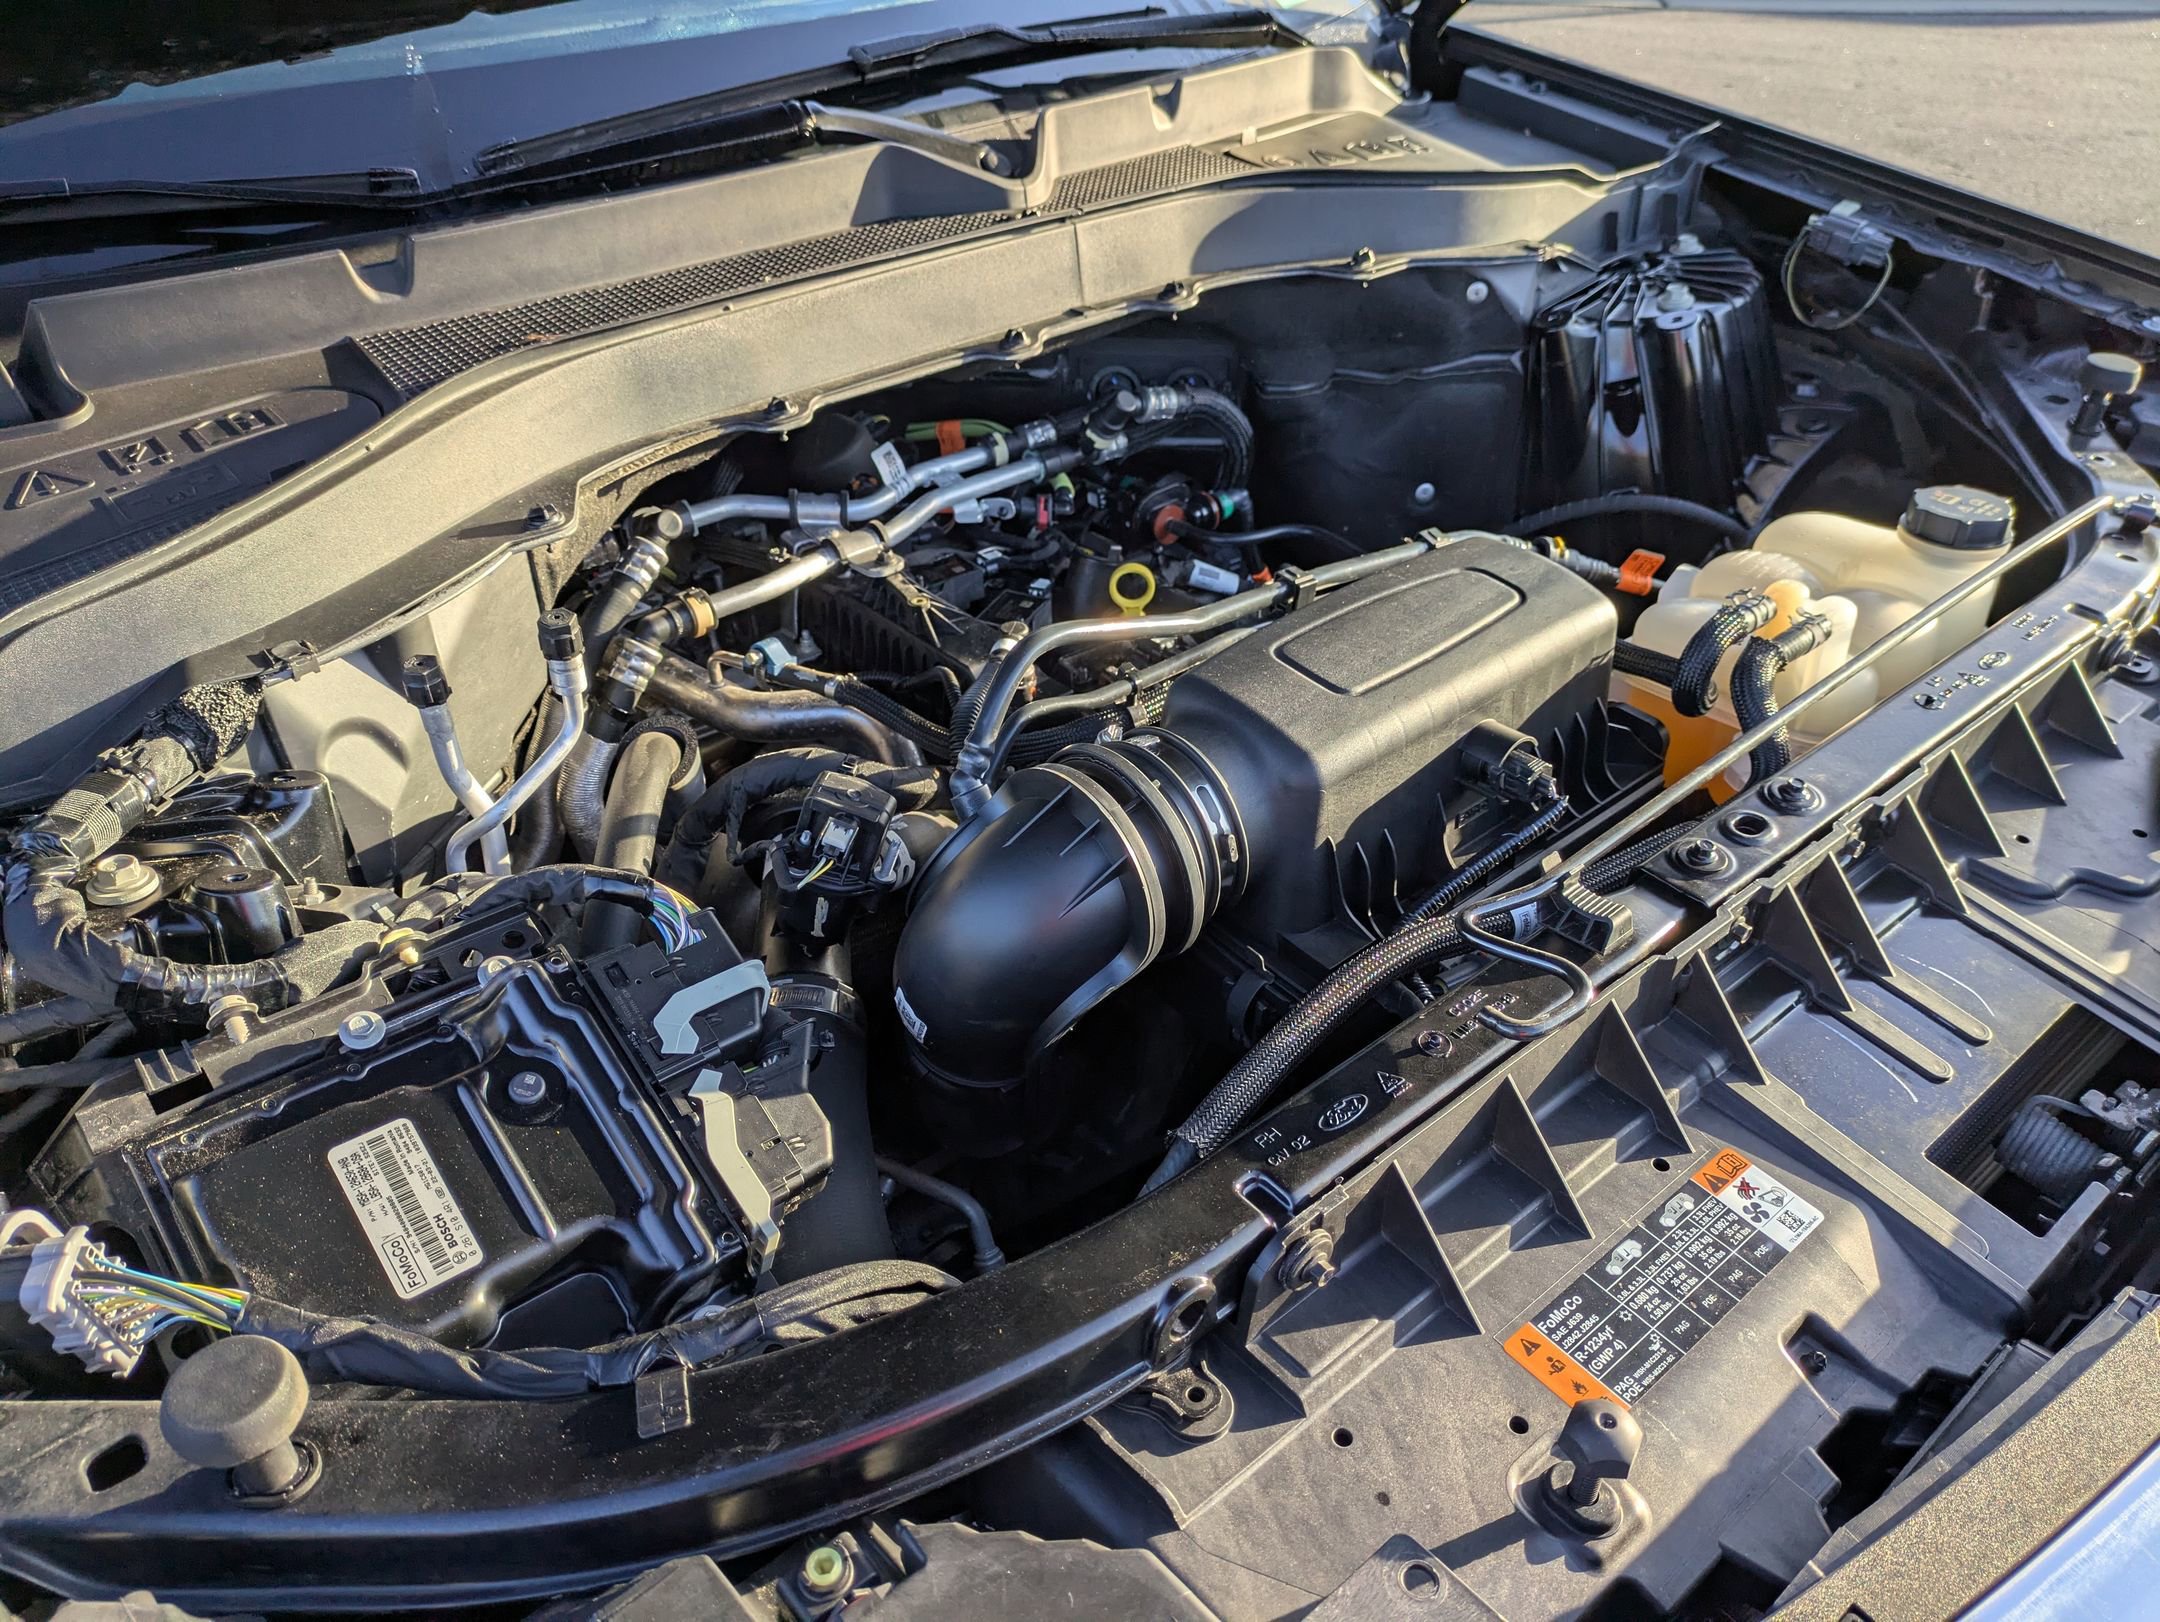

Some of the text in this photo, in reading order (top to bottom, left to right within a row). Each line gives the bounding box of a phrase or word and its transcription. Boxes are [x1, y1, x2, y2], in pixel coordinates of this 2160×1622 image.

[387, 1129, 402, 1153] Romania
[403, 1159, 414, 1175] Made
[1701, 1198, 1717, 1212] FHEV
[1708, 1202, 1724, 1217] PHEV
[433, 1213, 458, 1249] BOSCH
[1710, 1212, 1739, 1235] 0.992 kg
[1724, 1227, 1734, 1237] 35
[1739, 1227, 1751, 1236] lbs
[1683, 1235, 1713, 1258] 0.992 kg
[1698, 1250, 1708, 1260] 35
[1713, 1250, 1726, 1260] lbs
[1753, 1244, 1769, 1258] POE
[391, 1240, 420, 1288] FoMoCo
[1654, 1250, 1671, 1266] FHEV
[1655, 1260, 1686, 1285] 0.737 kg
[1686, 1276, 1698, 1286] lbs
[1728, 1269, 1743, 1283] PAG
[1616, 1289, 1631, 1301] 3.0L
[1632, 1275, 1646, 1287] 3.3L
[1629, 1285, 1659, 1309] 0.680 kg
[1643, 1297, 1661, 1312] 24 oz
[1649, 1301, 1672, 1320] 1.50 lbs
[1701, 1294, 1717, 1308] POE
[1537, 1295, 1582, 1333] FoMoCo
[1551, 1312, 1583, 1341] SAE J639
[1562, 1314, 1599, 1349] J2842 J2845
[1674, 1320, 1690, 1334] PAG
[1574, 1325, 1614, 1362] R-1234yf
[1588, 1339, 1627, 1374] (GWP 4)
[1613, 1375, 1634, 1394] PAG
[1622, 1382, 1644, 1402] POE
